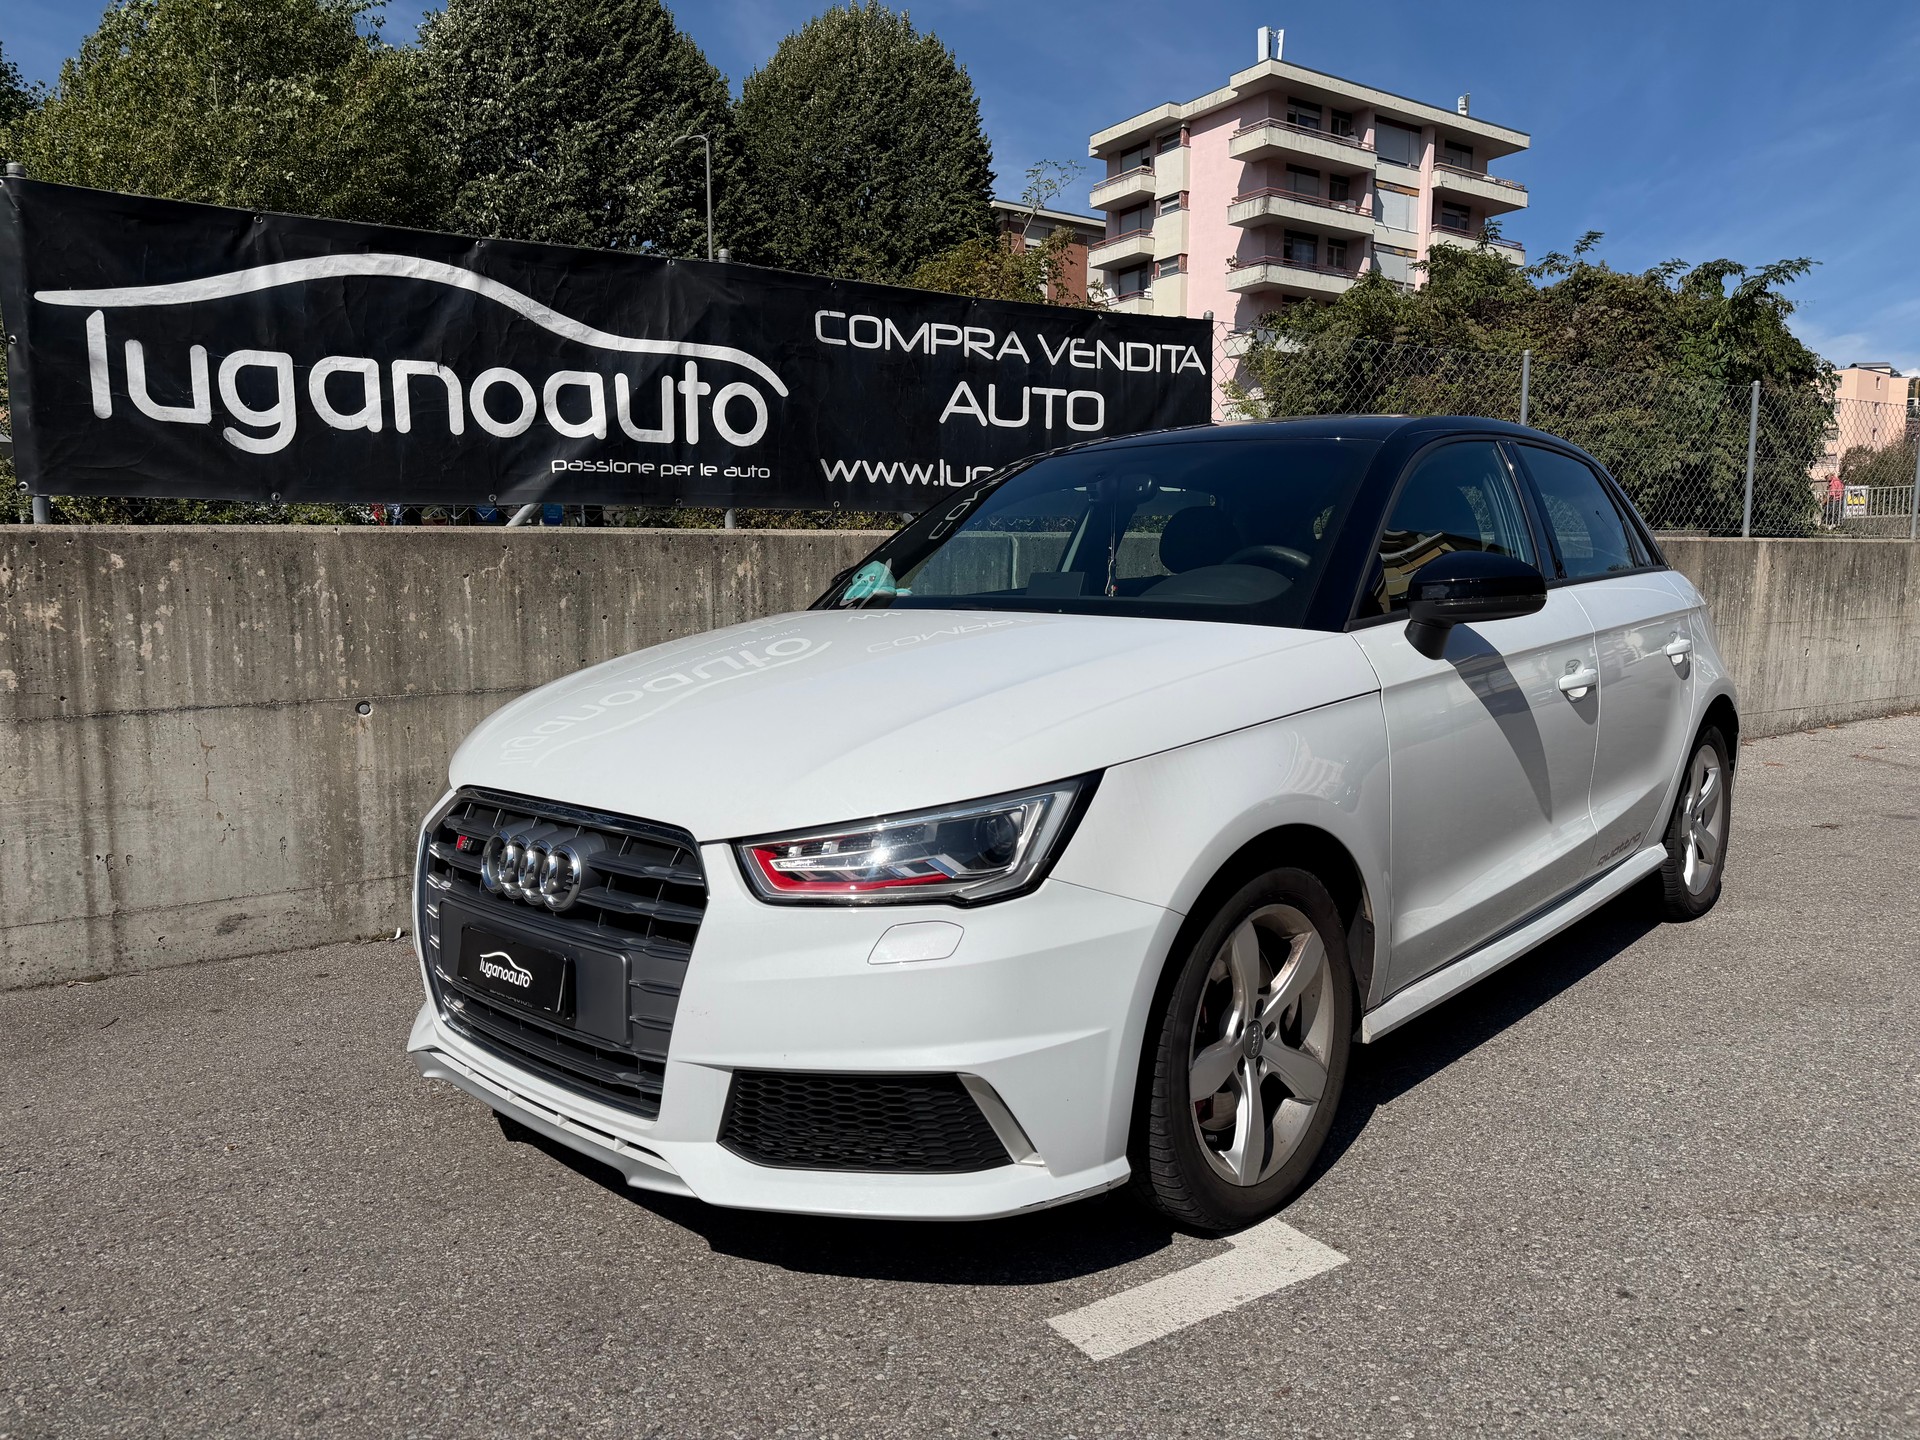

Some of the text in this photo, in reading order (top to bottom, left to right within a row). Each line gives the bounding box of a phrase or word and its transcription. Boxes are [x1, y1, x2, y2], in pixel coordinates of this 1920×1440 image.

[815, 310, 1206, 375] COMPRA VENDITA
[86, 309, 769, 454] luganoauto
[939, 381, 1104, 431] AUTO
[551, 459, 770, 478] passione per le auto
[480, 958, 530, 988] luganoauto
